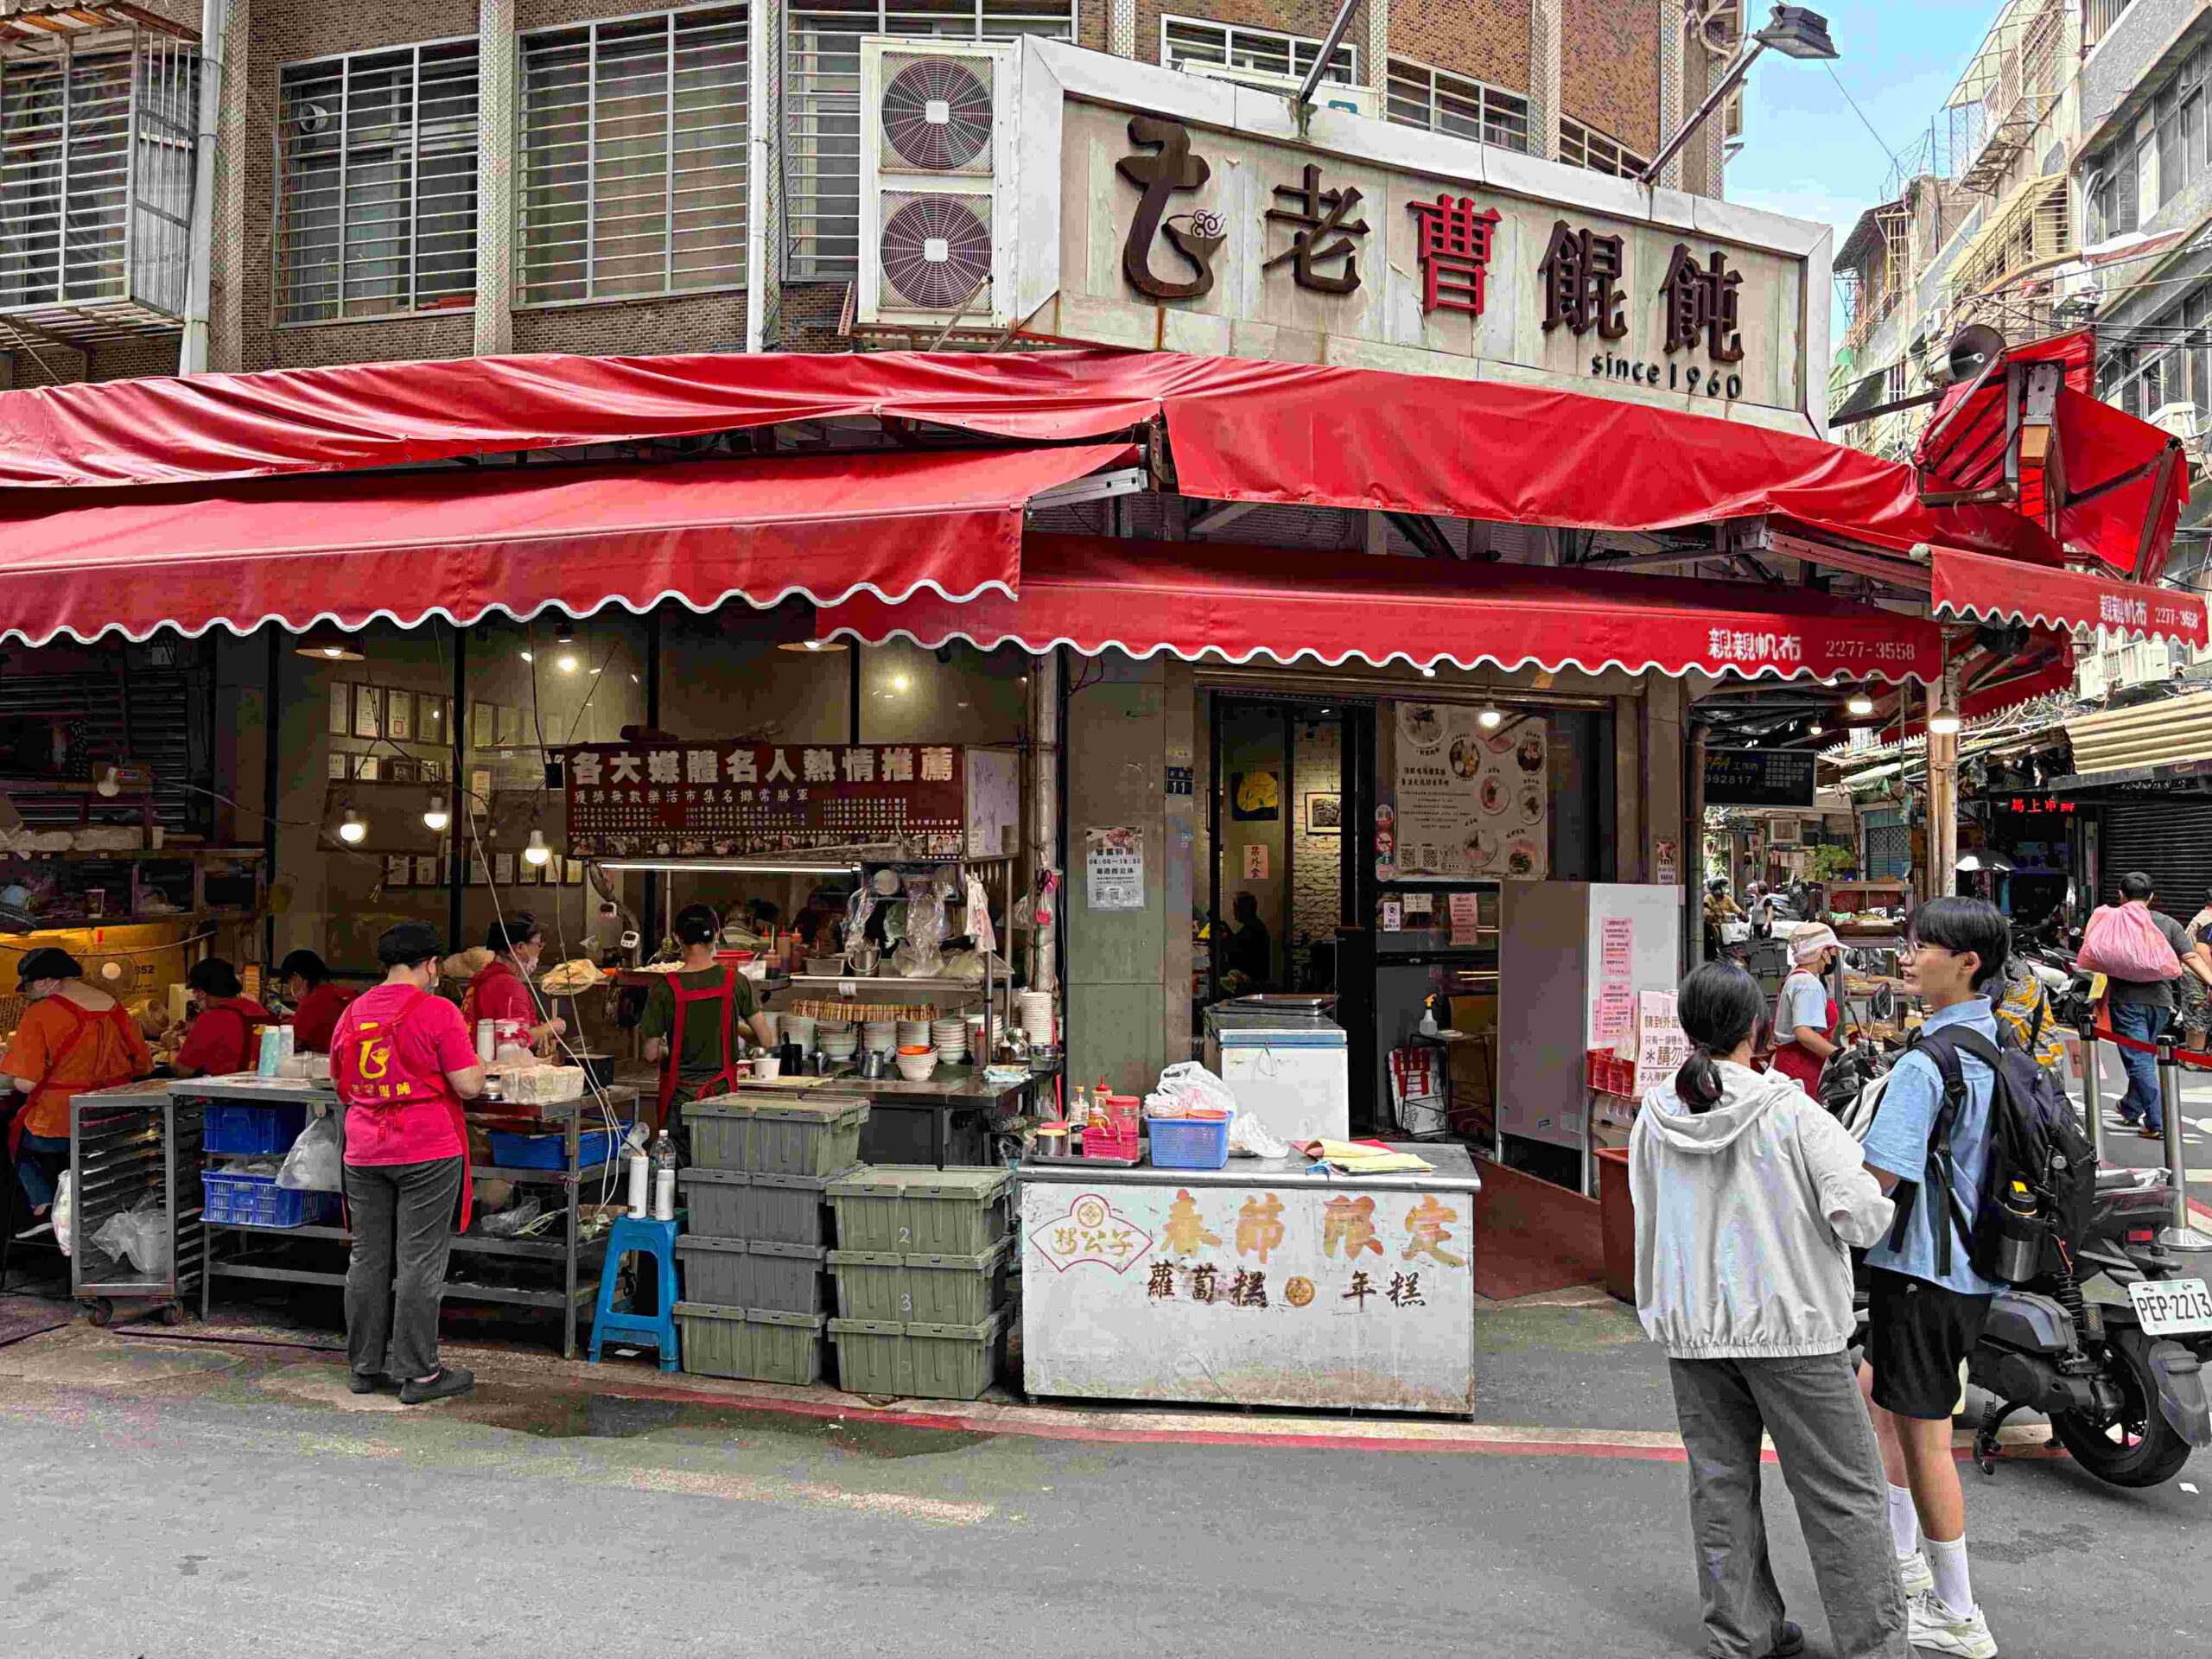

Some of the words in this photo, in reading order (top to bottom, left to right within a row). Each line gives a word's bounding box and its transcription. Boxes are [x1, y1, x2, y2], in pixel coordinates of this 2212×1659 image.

[1263, 163, 1745, 363] 老曹餛飩
[1825, 639, 1916, 662] 2277-3558
[571, 747, 953, 785] 各大媒體名人熱情推薦
[899, 1227, 911, 1244] 2
[1159, 1189, 1465, 1268] 春節限定
[900, 1294, 912, 1312] 3
[1147, 1261, 1268, 1309] 蘿蔔糕
[1342, 1270, 1426, 1313] 年糕
